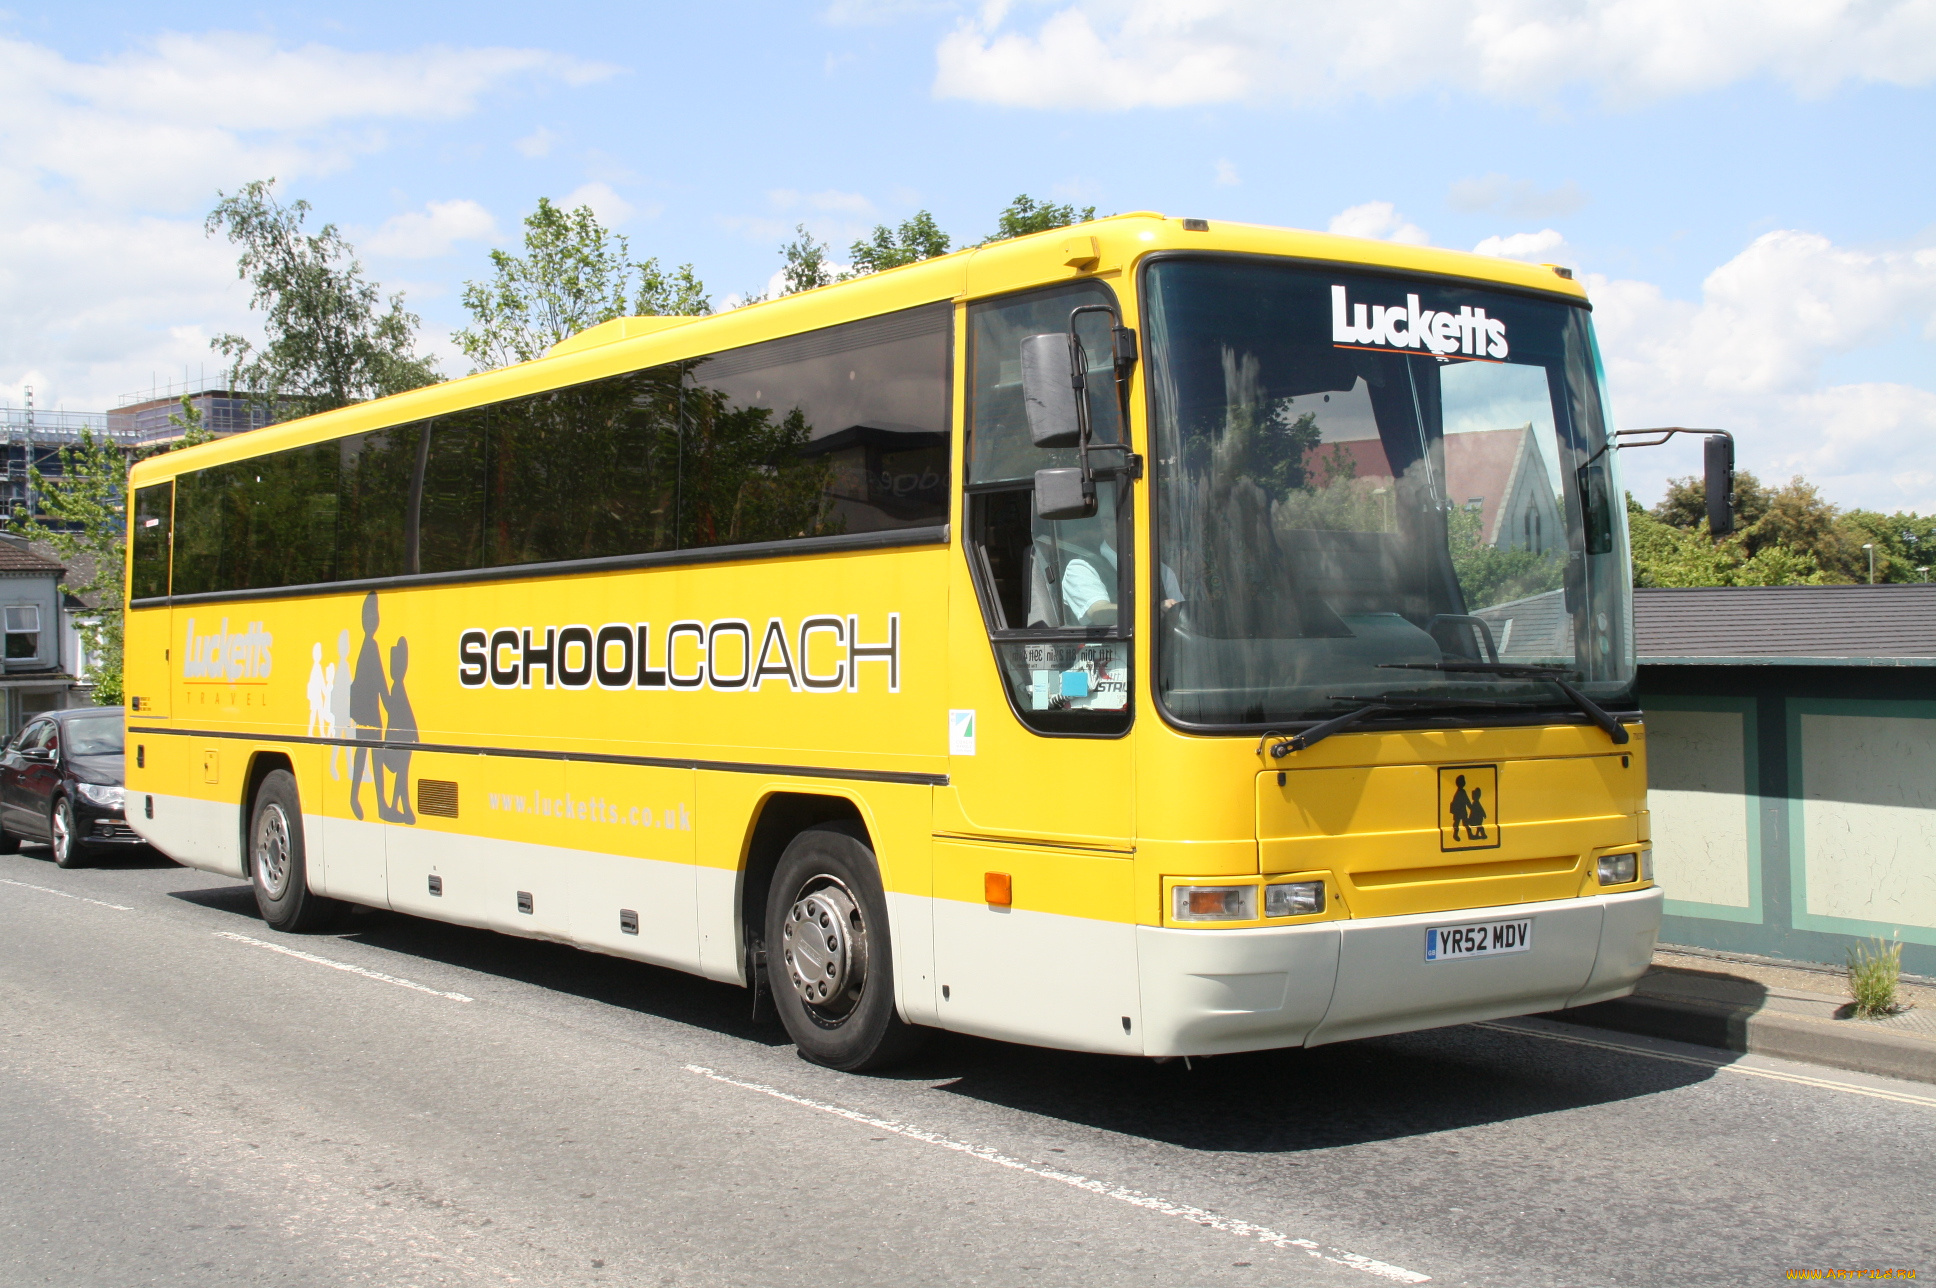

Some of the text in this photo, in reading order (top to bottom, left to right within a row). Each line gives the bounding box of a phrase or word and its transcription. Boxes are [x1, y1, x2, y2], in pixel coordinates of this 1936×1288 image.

[1331, 285, 1508, 360] Lucketts
[183, 617, 272, 681] Lucketts
[459, 612, 900, 693] SCHOOLCOACH
[187, 691, 266, 706] TRAVEL
[488, 789, 692, 832] www.lucketts.co.uk
[1440, 922, 1528, 955] YR52 MDV
